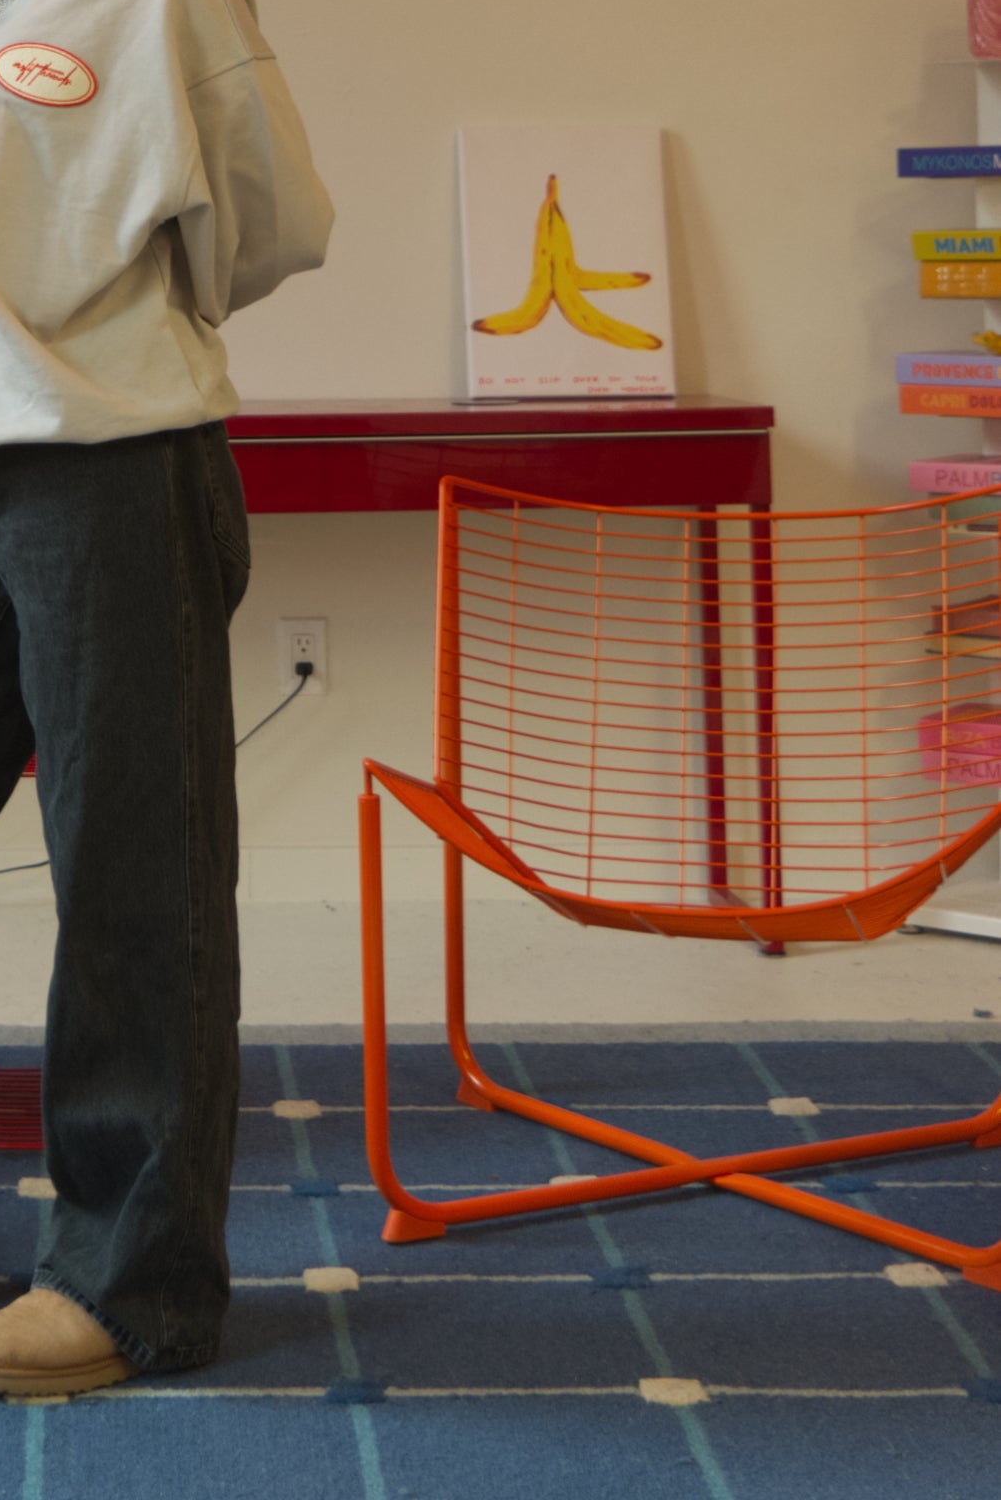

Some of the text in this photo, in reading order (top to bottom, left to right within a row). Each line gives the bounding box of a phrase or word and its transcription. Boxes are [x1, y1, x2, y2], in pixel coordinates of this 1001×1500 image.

[912, 153, 992, 171] MYKONOS
[934, 236, 994, 254] MIAMI
[911, 363, 993, 379] PROVENCE
[920, 393, 966, 408] CAPRI
[935, 469, 989, 487] PALM
